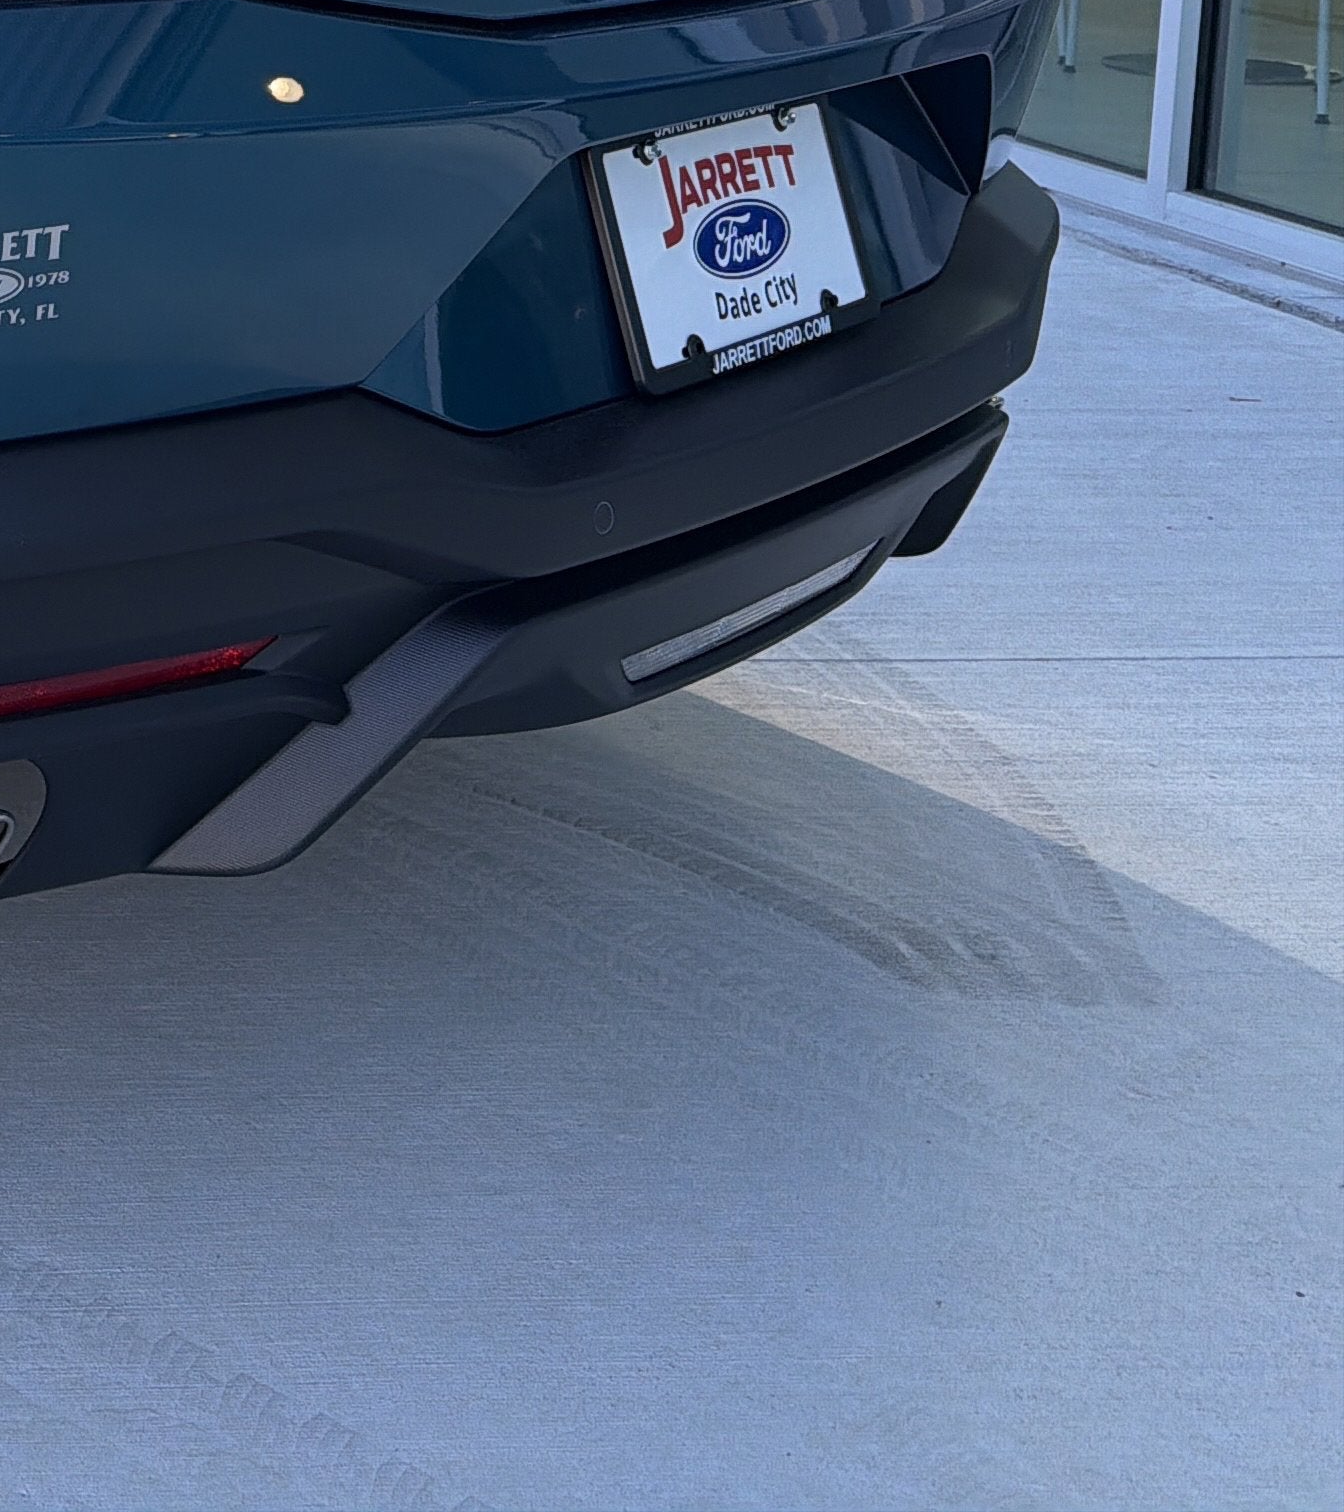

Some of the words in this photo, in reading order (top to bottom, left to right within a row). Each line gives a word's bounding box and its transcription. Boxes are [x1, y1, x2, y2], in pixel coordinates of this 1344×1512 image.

[657, 143, 796, 250] JARRETT
[713, 211, 773, 268] Ford
[27, 270, 71, 289] 1978
[714, 286, 763, 320] Dade
[765, 272, 800, 309] City
[35, 303, 60, 321] FL
[712, 314, 833, 375] JARRETTFORD.COM
